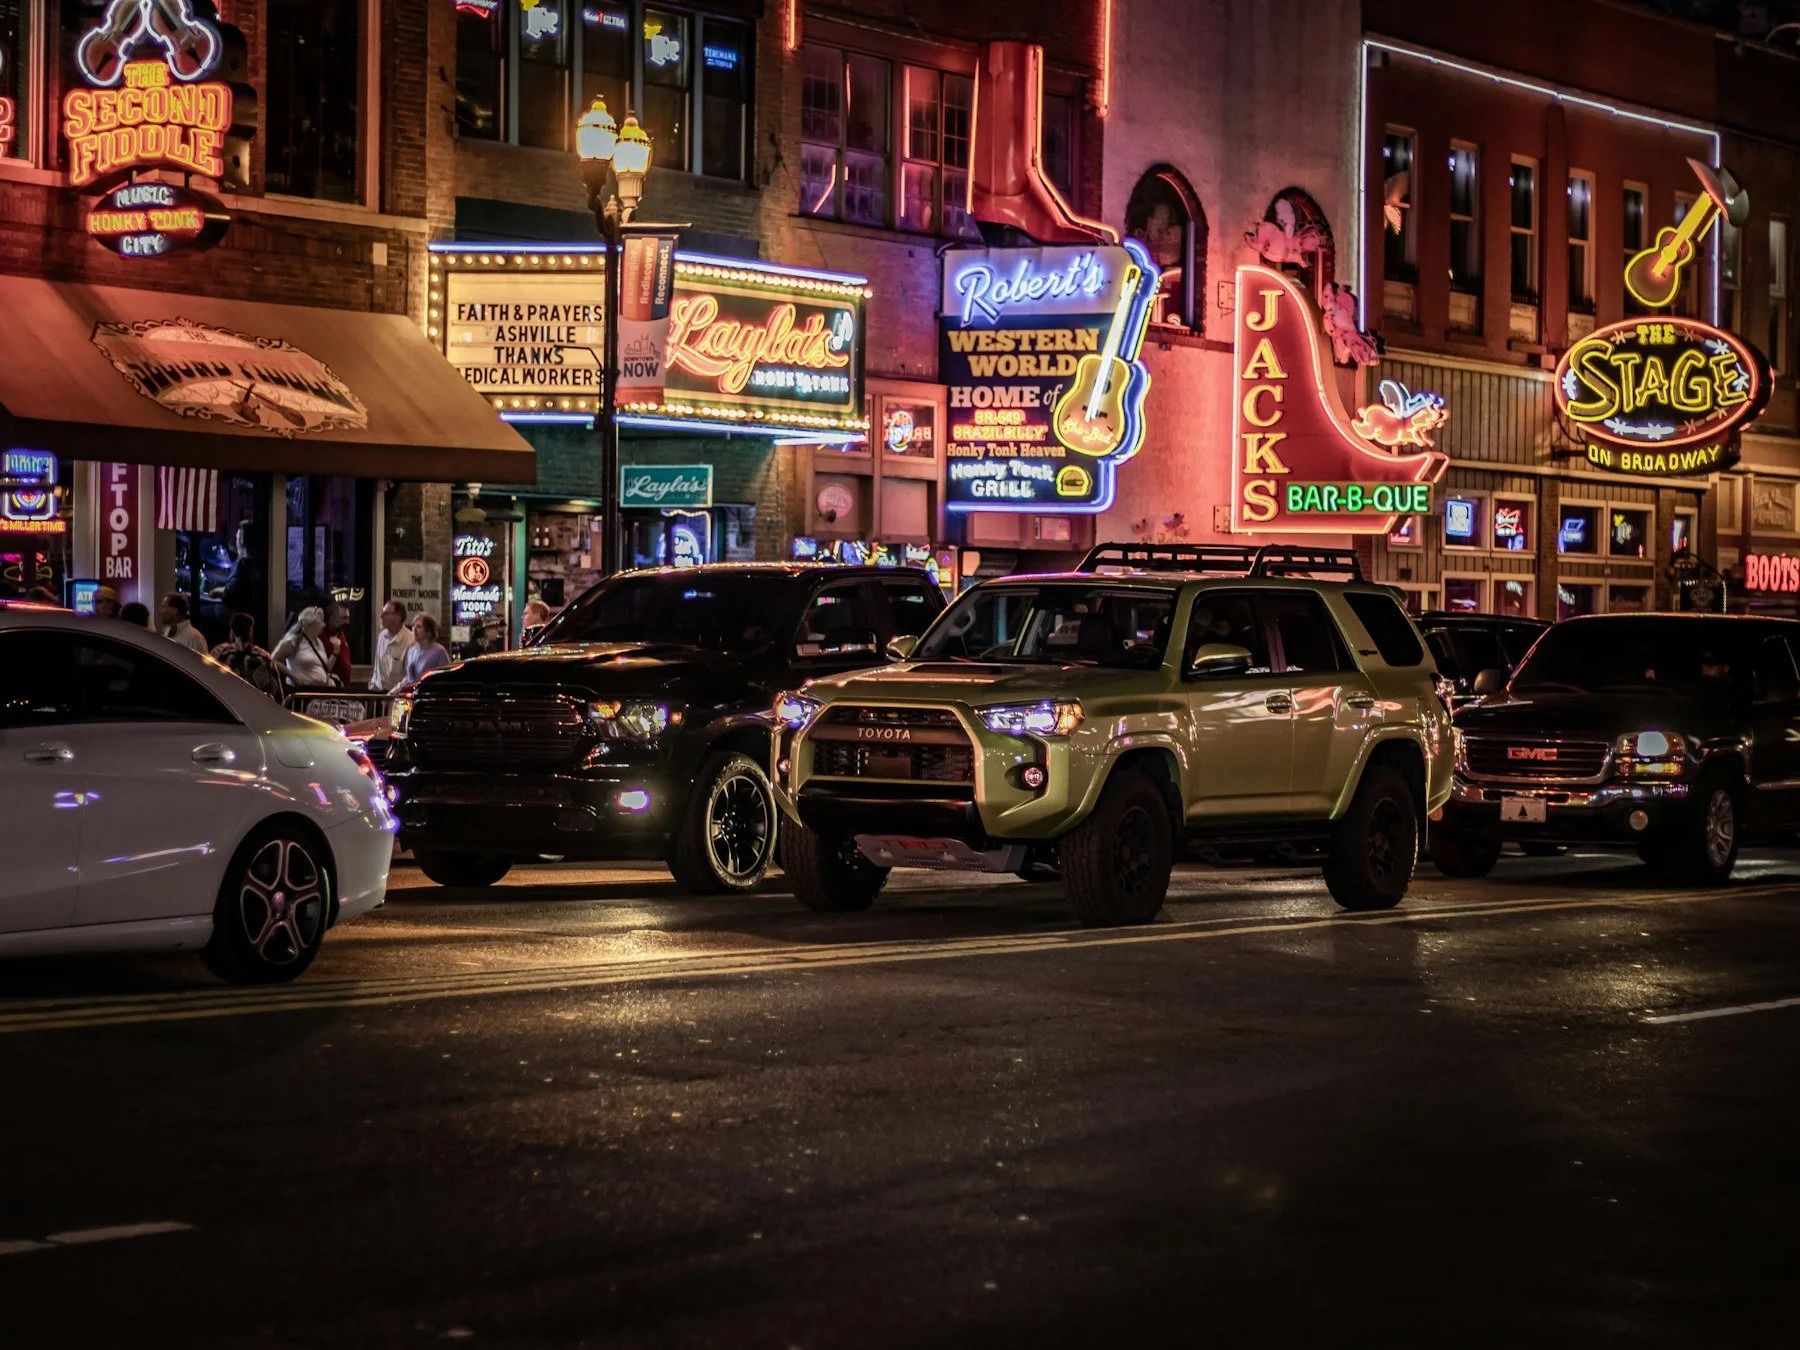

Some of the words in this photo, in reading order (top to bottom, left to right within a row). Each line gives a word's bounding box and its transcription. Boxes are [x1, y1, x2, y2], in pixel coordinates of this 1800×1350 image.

[124, 62, 169, 87] THE
[65, 85, 231, 138] SECOND
[70, 124, 222, 184] FIDDLE
[116, 186, 174, 207] MUSIC
[88, 212, 147, 232] HONKY
[148, 210, 202, 230] TONK
[121, 234, 165, 253] CITY
[655, 246, 670, 304] Reconnect.
[956, 253, 1106, 327] Robert's
[458, 304, 509, 320] FAITH
[513, 304, 524, 321] &
[527, 304, 603, 322] PRAYERS
[496, 325, 576, 343] ASHVILLE
[665, 295, 850, 393] Layla's
[948, 328, 1100, 352] WESTERN
[1636, 324, 1677, 345] THE
[494, 347, 564, 364] THANKS
[967, 355, 1078, 377] WORLD
[457, 367, 519, 384] EDICAL
[522, 367, 604, 386] WORKERS
[623, 362, 659, 377] NOW
[1566, 339, 1749, 422] STAGE
[950, 386, 1040, 408] HOME
[1043, 384, 1063, 412] of
[1241, 289, 1291, 522] JACKS
[947, 442, 985, 460] Honky
[987, 442, 1018, 457] Tonk
[1021, 443, 1066, 457] Heaven
[1588, 444, 1613, 467] ON
[1621, 444, 1721, 472] BROADWAY
[625, 474, 707, 501] Layla's
[971, 480, 1035, 497] GRILL
[1286, 484, 1431, 513] BAR-B-QUE
[10, 520, 41, 532] MILLER
[42, 520, 66, 532] TIME
[456, 536, 494, 556] Tito's
[105, 556, 133, 578] BAR
[1745, 554, 1800, 592] BOOTS
[411, 575, 423, 585] THE
[392, 589, 417, 598] ROBERT
[418, 590, 440, 599] MOORE
[462, 601, 493, 612] VODKA
[857, 727, 911, 740] TOYOTA
[1507, 746, 1558, 761] GMC
